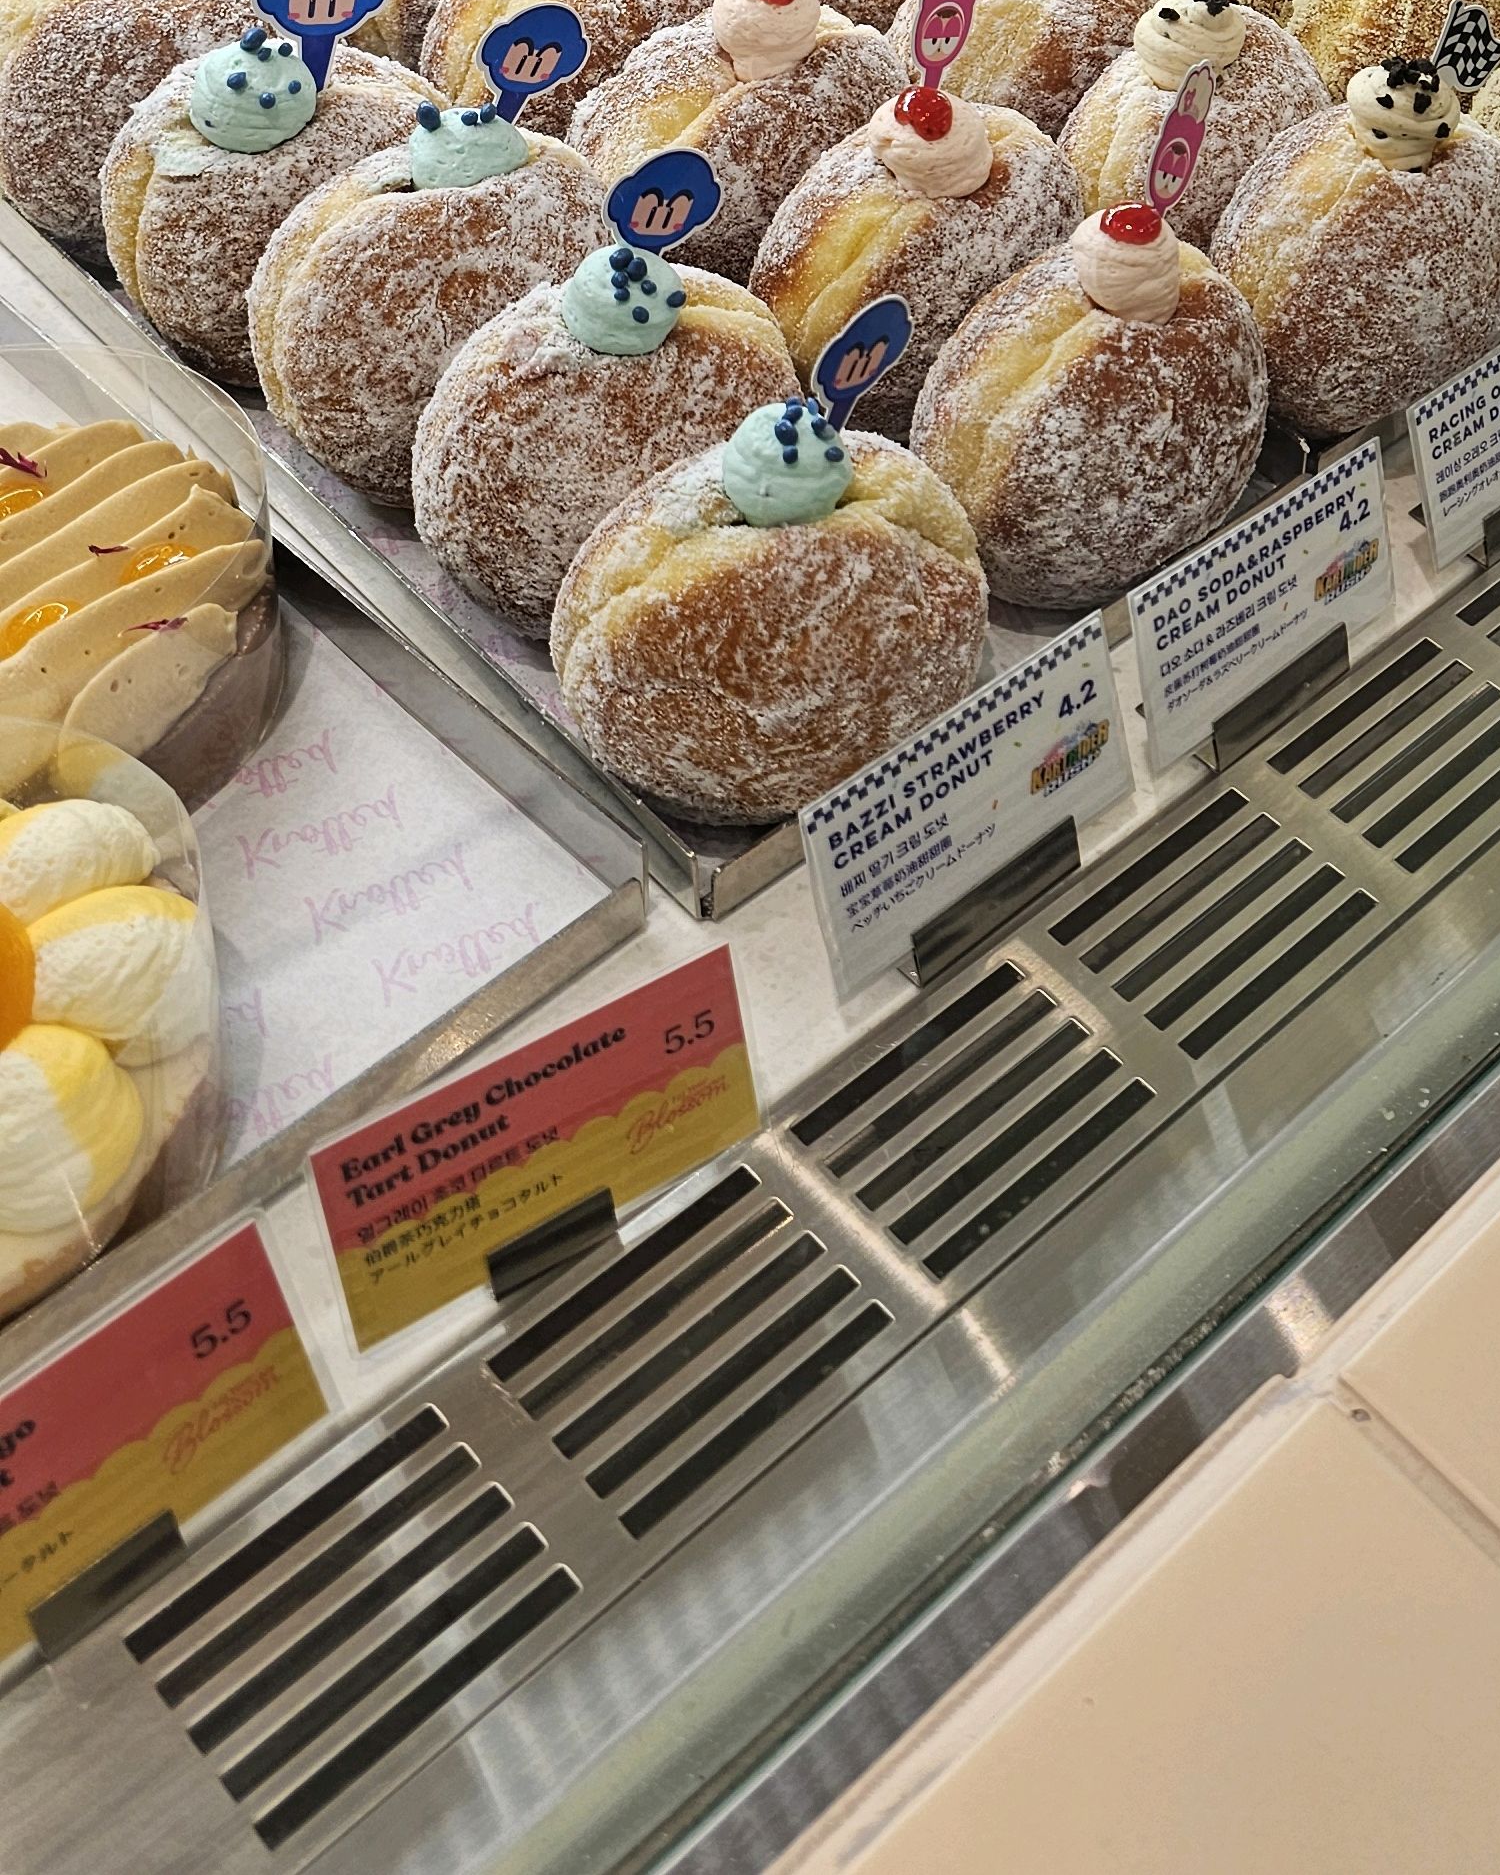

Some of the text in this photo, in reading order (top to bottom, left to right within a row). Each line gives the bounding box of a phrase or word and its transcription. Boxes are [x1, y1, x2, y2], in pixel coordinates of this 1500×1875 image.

[1428, 395, 1486, 444] RACING
[1432, 415, 1484, 460] CREAM
[1435, 458, 1462, 484] 레이싱
[1463, 440, 1488, 466] 오레오
[1340, 498, 1370, 532] 4.2
[1153, 486, 1356, 632] DAO SODA&RASPBERRY
[1156, 553, 1287, 650] CREAM DONUT
[1160, 574, 1298, 677] 다오 소다 & 라즈베리 크림 도넛
[1058, 679, 1098, 718] 4.2
[828, 690, 1044, 851] BAZZI STRAWBERRY
[834, 749, 993, 869] CREAM DONUT
[840, 813, 949, 898] 배찌 딸기 크림 도넛
[665, 1009, 715, 1054] 5.5
[339, 1027, 626, 1183] Earl Grey Chocolate
[527, 1126, 560, 1154] 도넛
[346, 1114, 510, 1209] Tart Donut
[370, 1173, 563, 1284] アールグレイチョコタルト
[190, 1298, 251, 1359] 5.5
